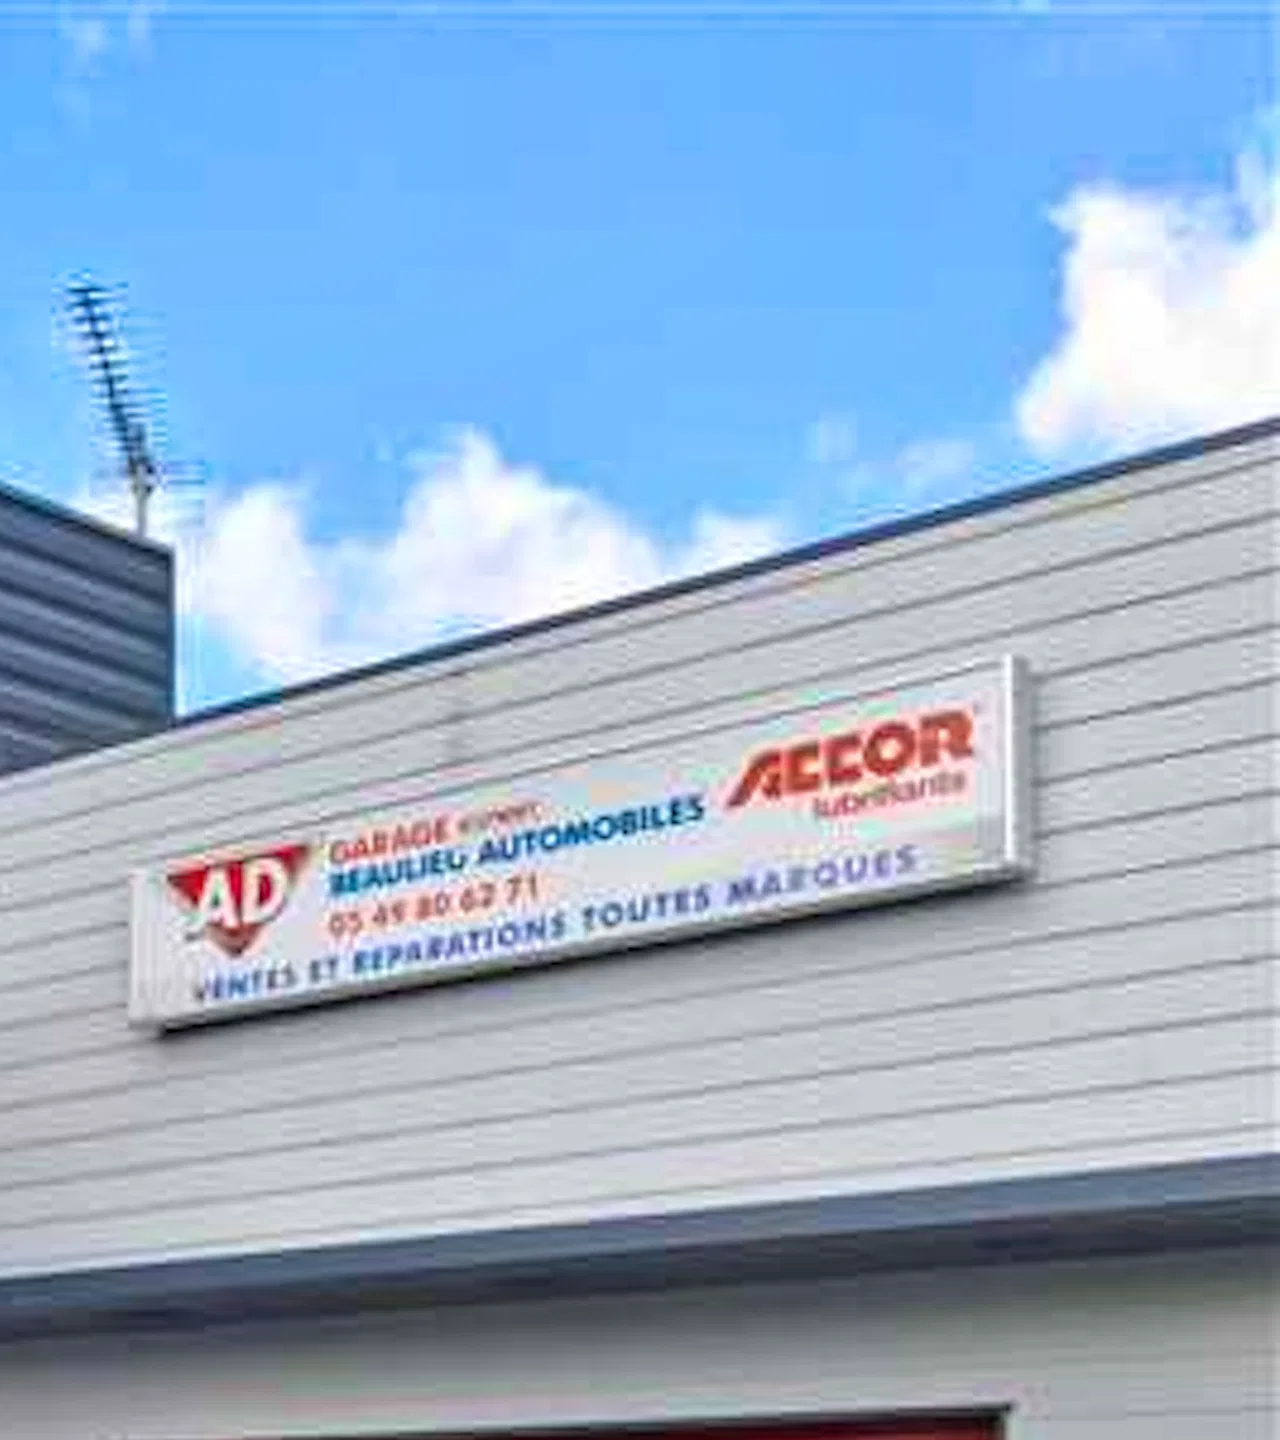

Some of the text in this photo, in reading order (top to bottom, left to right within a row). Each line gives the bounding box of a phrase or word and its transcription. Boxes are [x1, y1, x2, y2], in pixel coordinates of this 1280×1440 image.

[725, 710, 975, 809] ACCOR
[329, 811, 452, 863] GARAGE
[329, 796, 705, 897] BEAULIEU AUTOMOBILES
[186, 856, 289, 930] AD
[197, 959, 296, 1000] VENTES
[308, 957, 340, 984] ET
[582, 884, 711, 932] TOUTES
[727, 845, 917, 906] MARQUES
[329, 911, 363, 937] 05
[372, 902, 407, 927] 49
[417, 894, 451, 919] 80
[506, 875, 540, 902] 71
